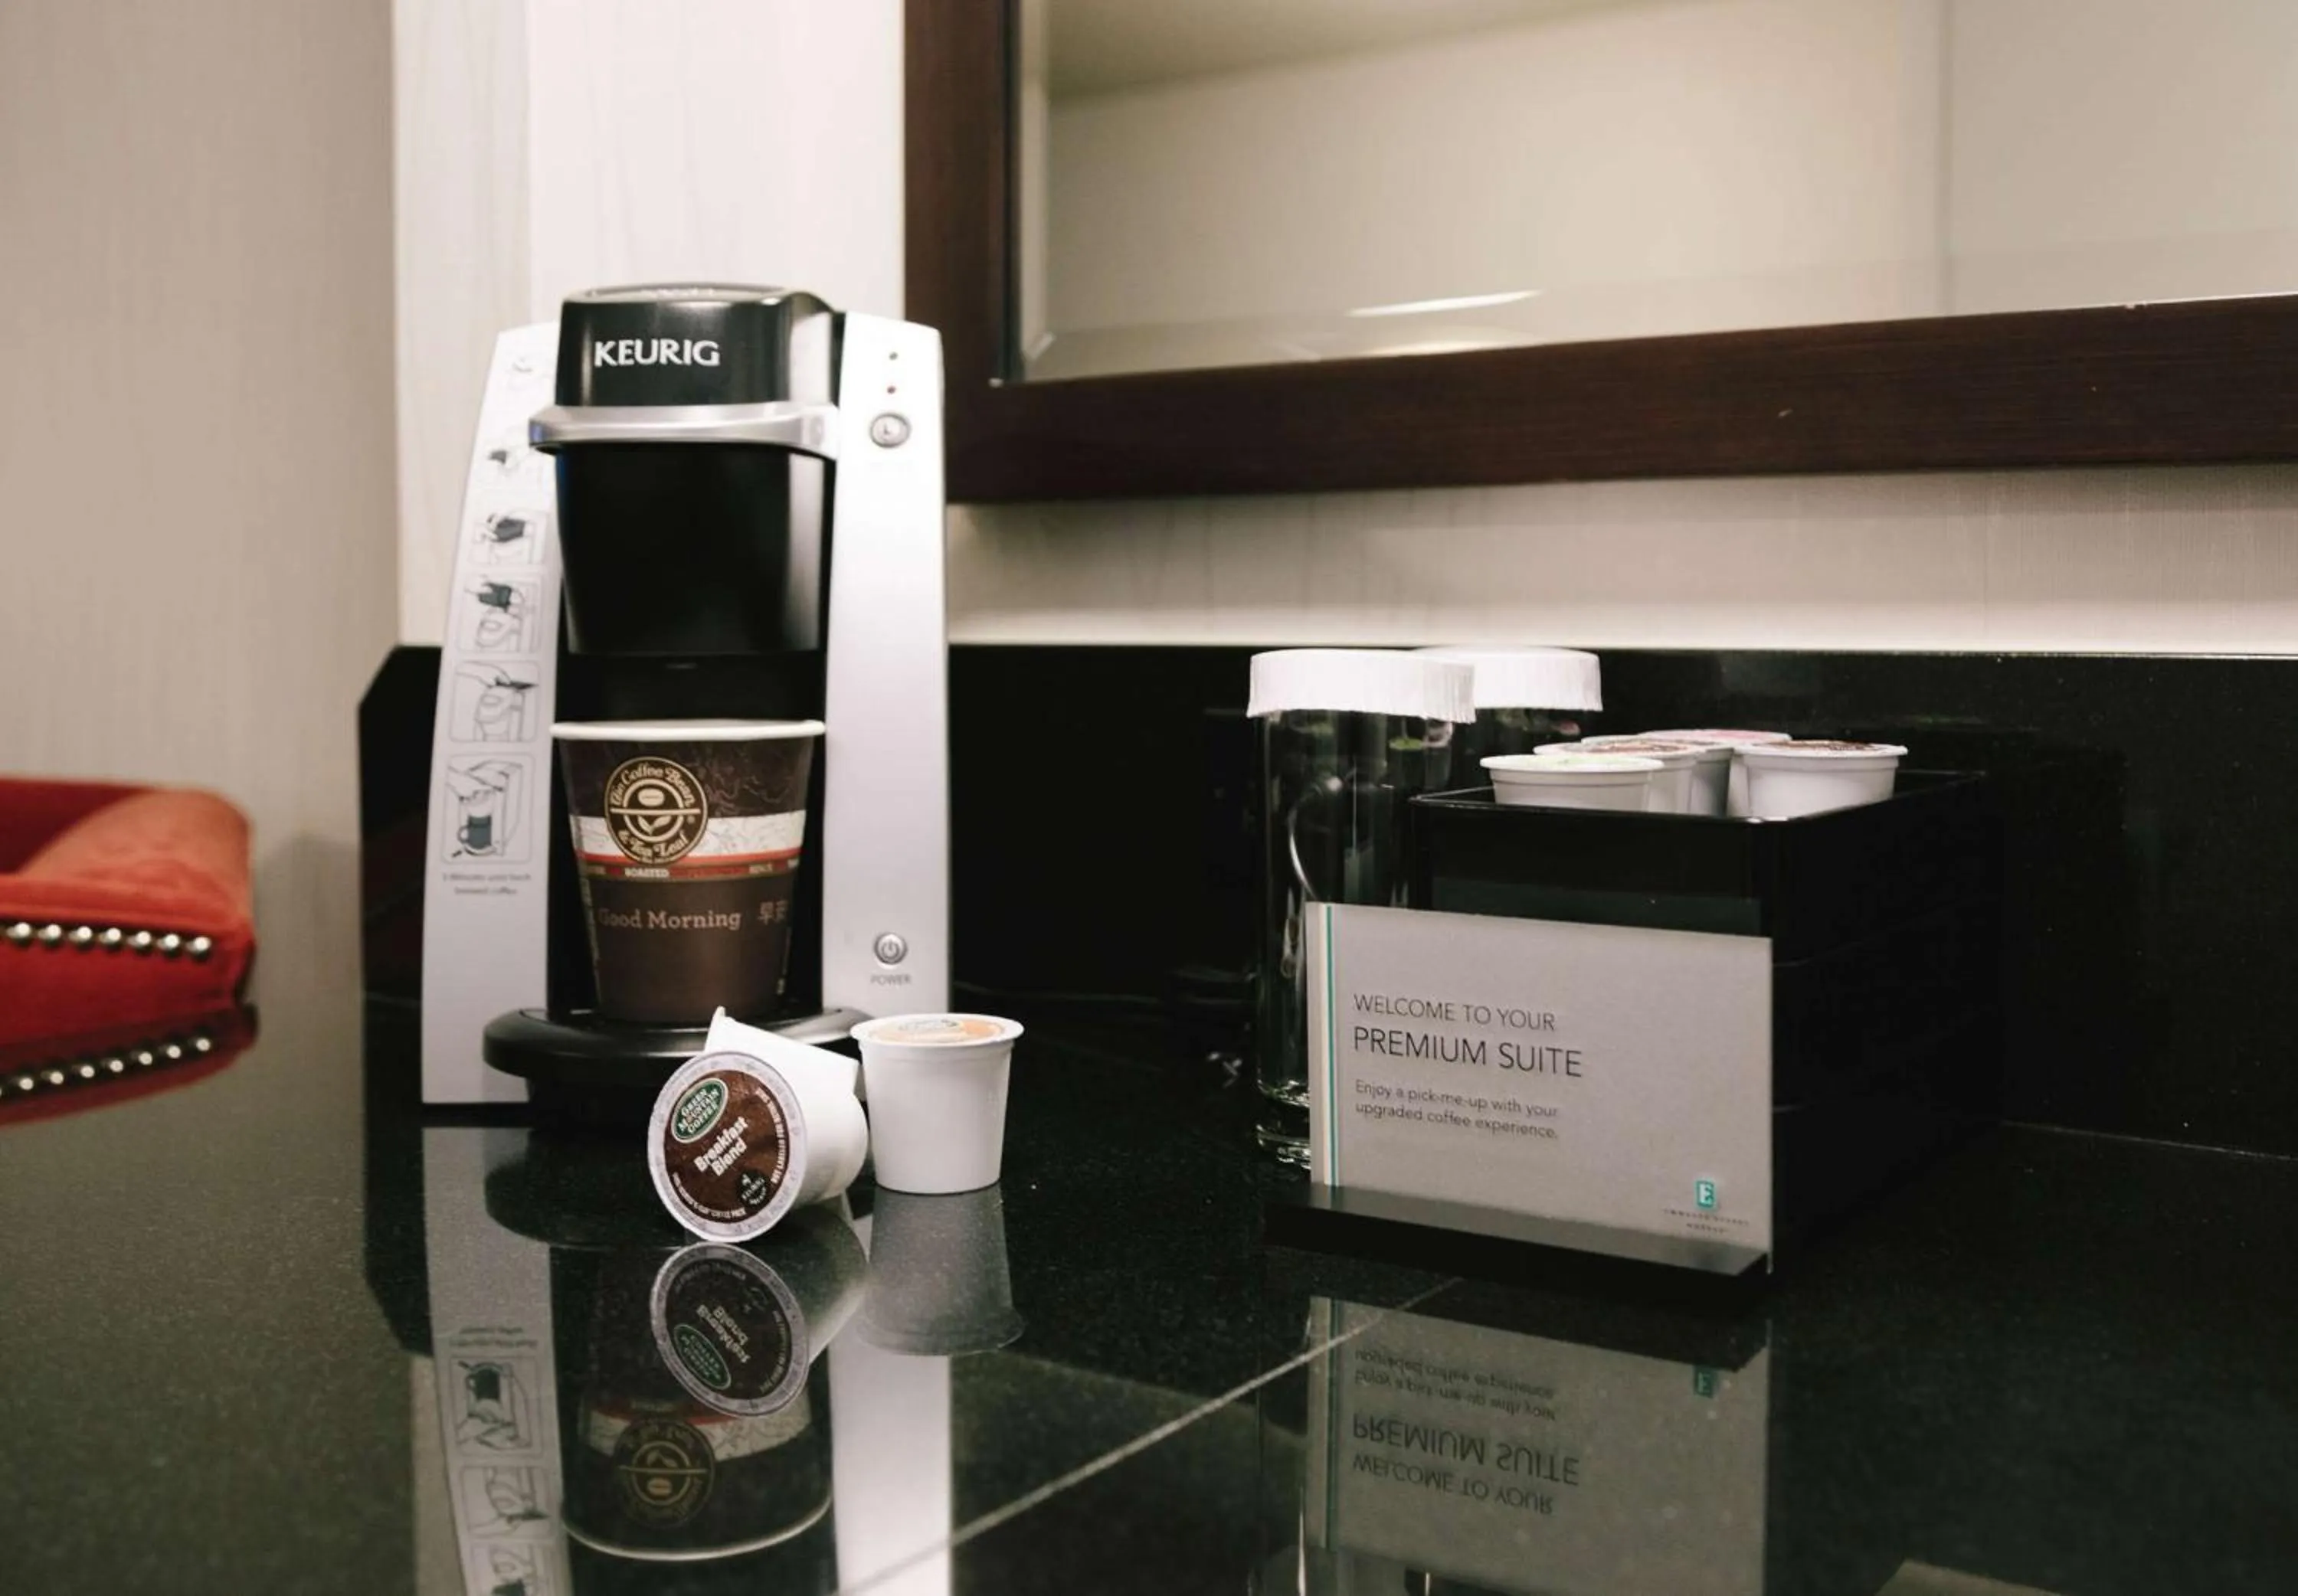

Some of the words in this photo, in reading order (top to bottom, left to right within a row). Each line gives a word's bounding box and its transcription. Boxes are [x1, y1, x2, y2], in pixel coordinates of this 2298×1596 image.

[594, 338, 721, 367] KEURIG
[620, 762, 664, 785] Coffee
[665, 767, 696, 806] Bean
[653, 829, 688, 857] Leaf
[597, 908, 642, 928] Good
[647, 909, 742, 930] Morning
[1354, 993, 1455, 1022] WELCOME
[1463, 1004, 1491, 1025] TO
[1497, 1007, 1556, 1031] YOUR
[1354, 1026, 1488, 1066] PREMIUM
[1498, 1042, 1583, 1077] SUITE
[1355, 1079, 1393, 1100] Enjoy
[1396, 1087, 1404, 1098] a
[1408, 1087, 1489, 1110] pick-me-up
[1491, 1098, 1522, 1113] with
[1526, 1105, 1558, 1118] your
[1355, 1101, 1423, 1120] upgraded
[1427, 1110, 1471, 1127] coffee
[1475, 1119, 1560, 1140] experience.
[693, 1116, 748, 1172] Breakfast
[711, 1136, 748, 1176] Blend
